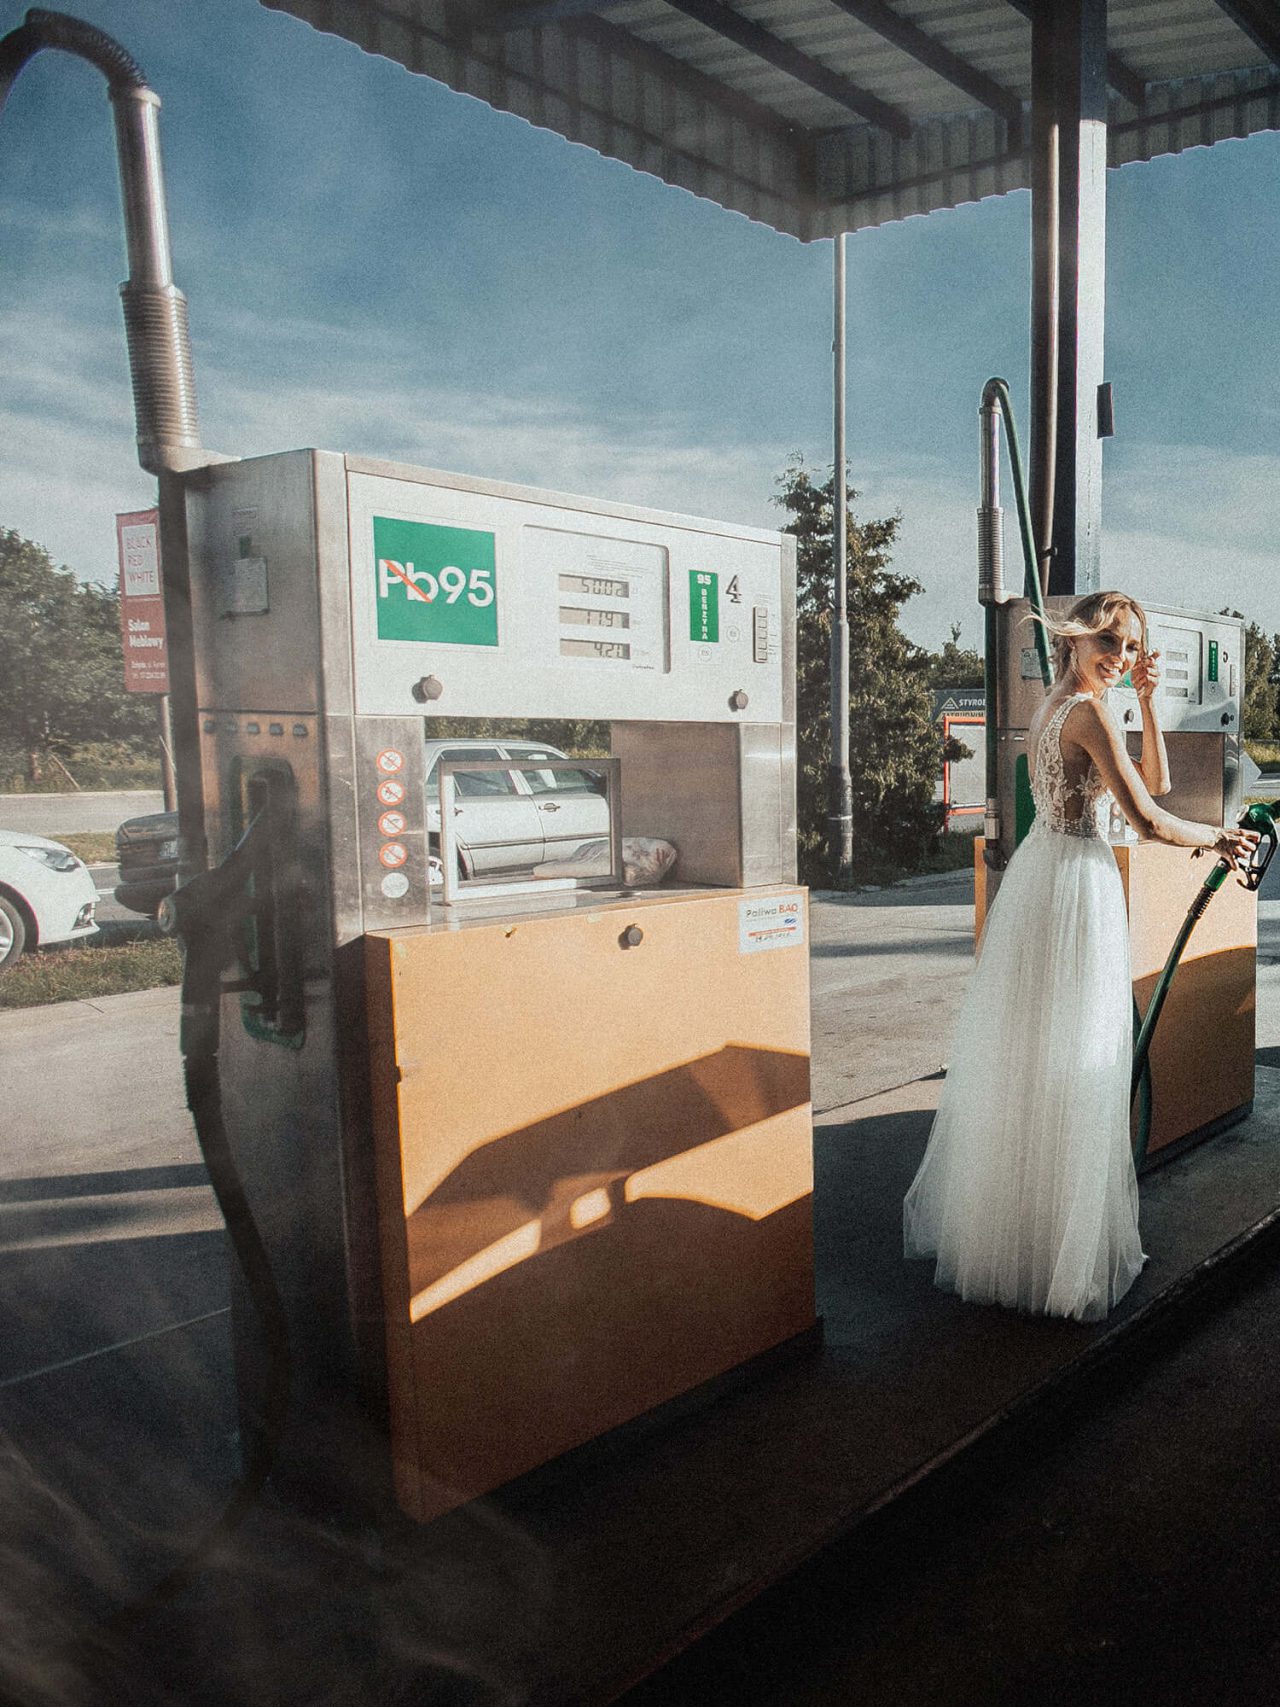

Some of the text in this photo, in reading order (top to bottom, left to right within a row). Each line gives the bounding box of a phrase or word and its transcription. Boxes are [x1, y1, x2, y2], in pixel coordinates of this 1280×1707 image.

[378, 558, 494, 608] Pb95
[697, 573, 712, 585] 95
[725, 574, 742, 604] 4
